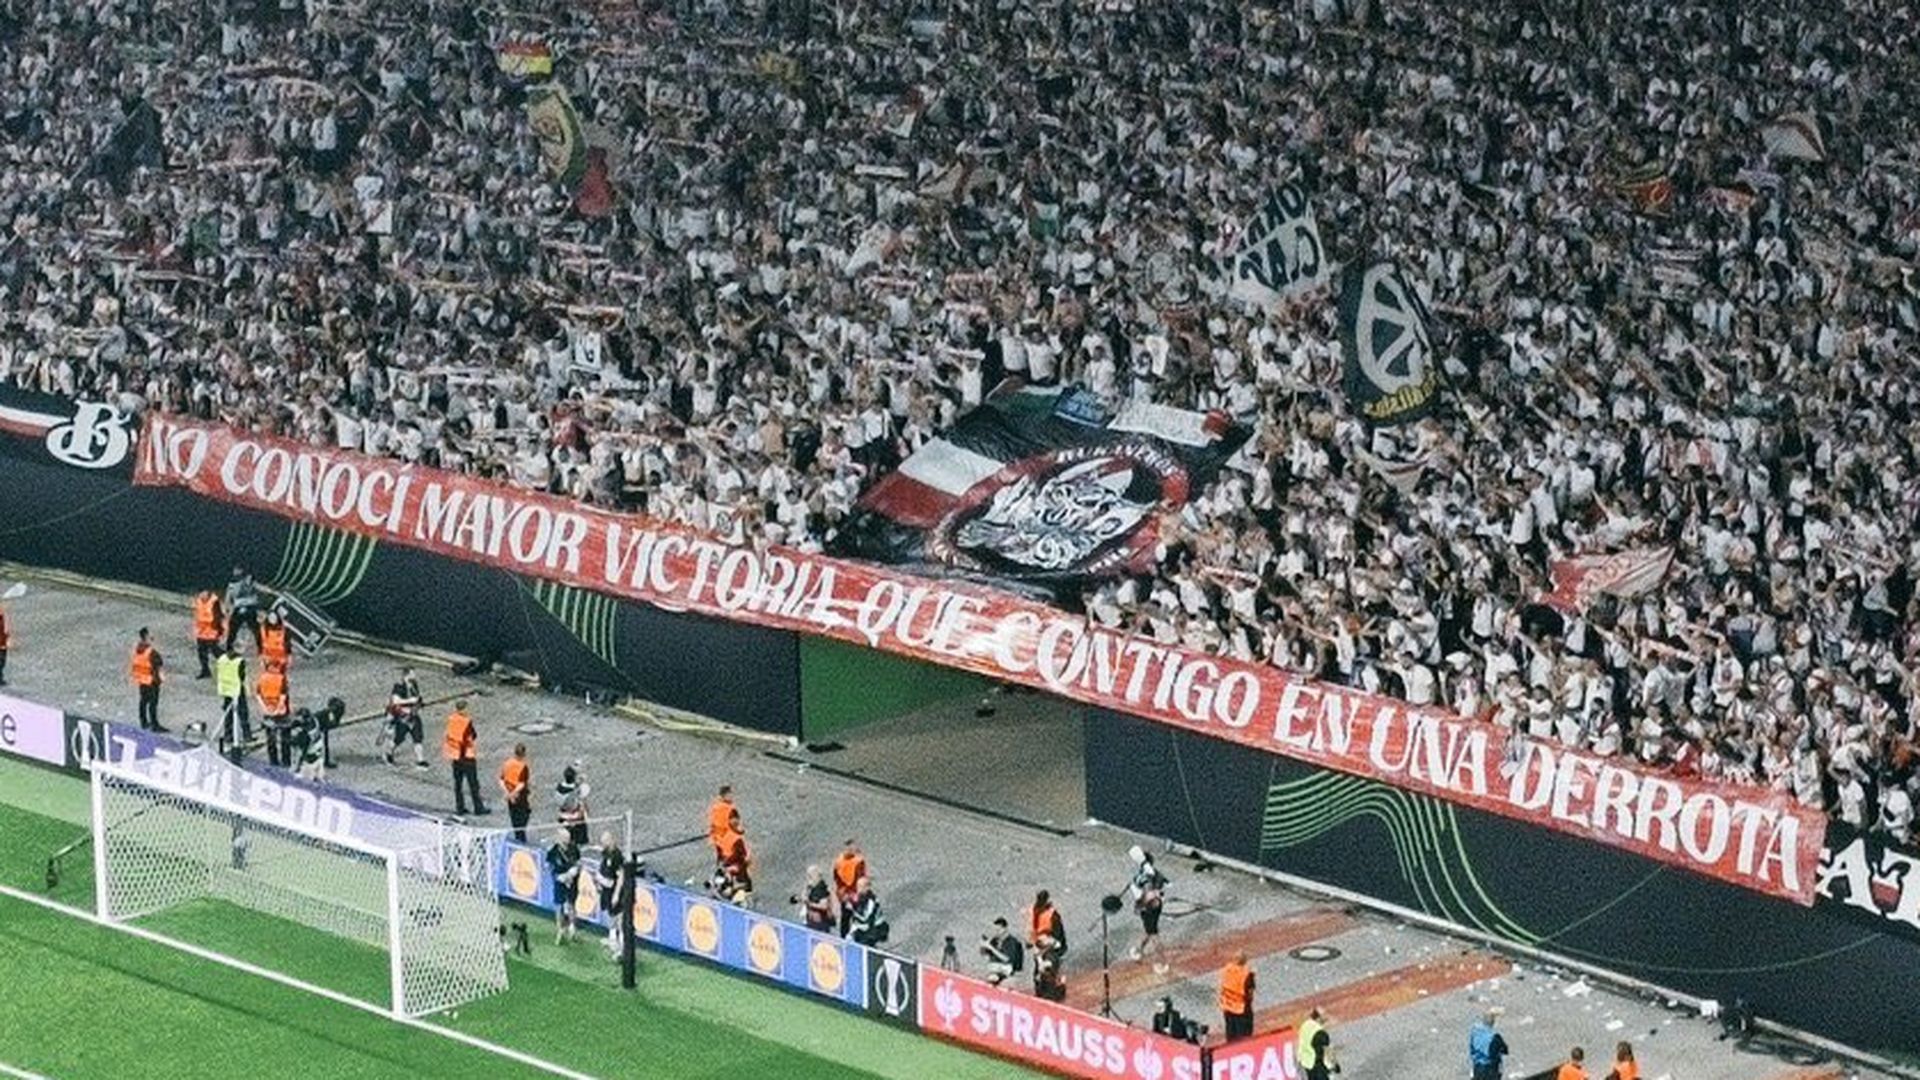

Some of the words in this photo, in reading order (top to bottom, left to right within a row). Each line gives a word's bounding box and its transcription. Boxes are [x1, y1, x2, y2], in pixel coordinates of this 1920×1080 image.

[143, 418, 207, 479] NO
[220, 440, 412, 534] CONOCÍ
[415, 482, 588, 575] MAYOR
[603, 522, 838, 626] VICTORIA
[857, 579, 988, 652] QUE
[996, 611, 1260, 729] CONTIGO
[1272, 683, 1361, 756] EN
[1369, 709, 1487, 795] UNA
[1506, 742, 1799, 892] DERROTA
[970, 993, 1126, 1076] STRAUSS
